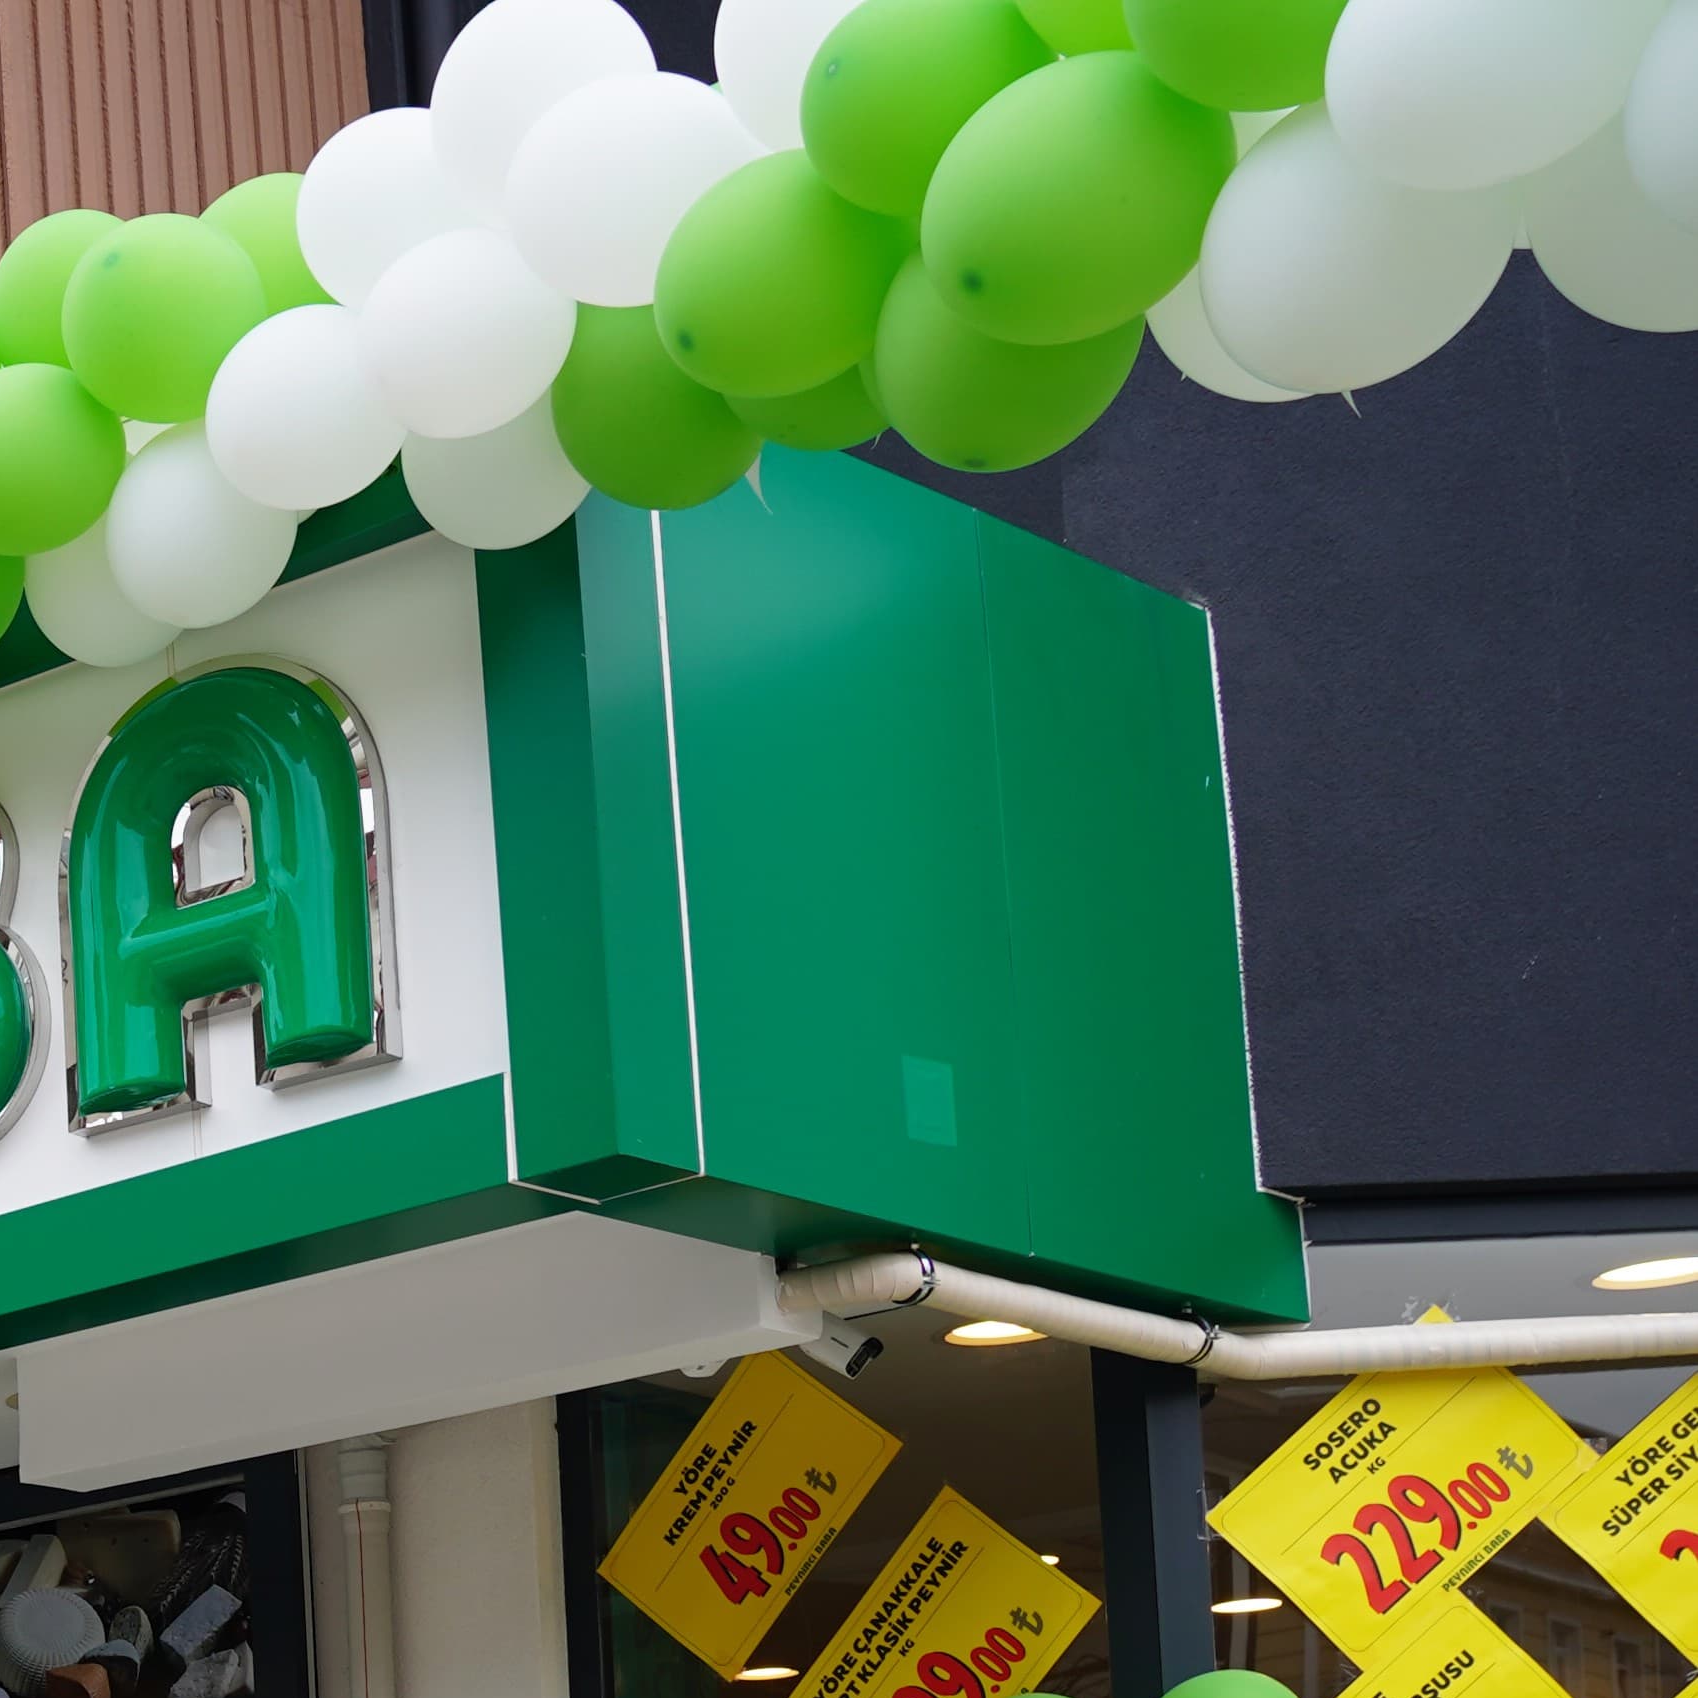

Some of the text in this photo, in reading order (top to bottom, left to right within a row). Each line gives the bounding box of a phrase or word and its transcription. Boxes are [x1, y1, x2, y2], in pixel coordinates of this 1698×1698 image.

[1303, 1398, 1381, 1471] SOSERO
[1328, 1421, 1397, 1485] ACUKA
[1366, 1456, 1386, 1475] KG
[1615, 1436, 1675, 1487] YÖRE
[663, 1421, 757, 1546] KREM PEYNİR
[673, 1443, 717, 1496] YÖRE
[710, 1487, 729, 1510] 200
[1602, 1477, 1670, 1537] SÜPER
[699, 1487, 821, 1605] 49.00
[1320, 1462, 1510, 1615] 229.00
[1483, 1529, 1511, 1553] BABA
[853, 1536, 944, 1655] ÇANAKKALE
[856, 1611, 914, 1684] KLASİK
[908, 1540, 969, 1615] PEYNİR
[898, 1639, 915, 1657] KG
